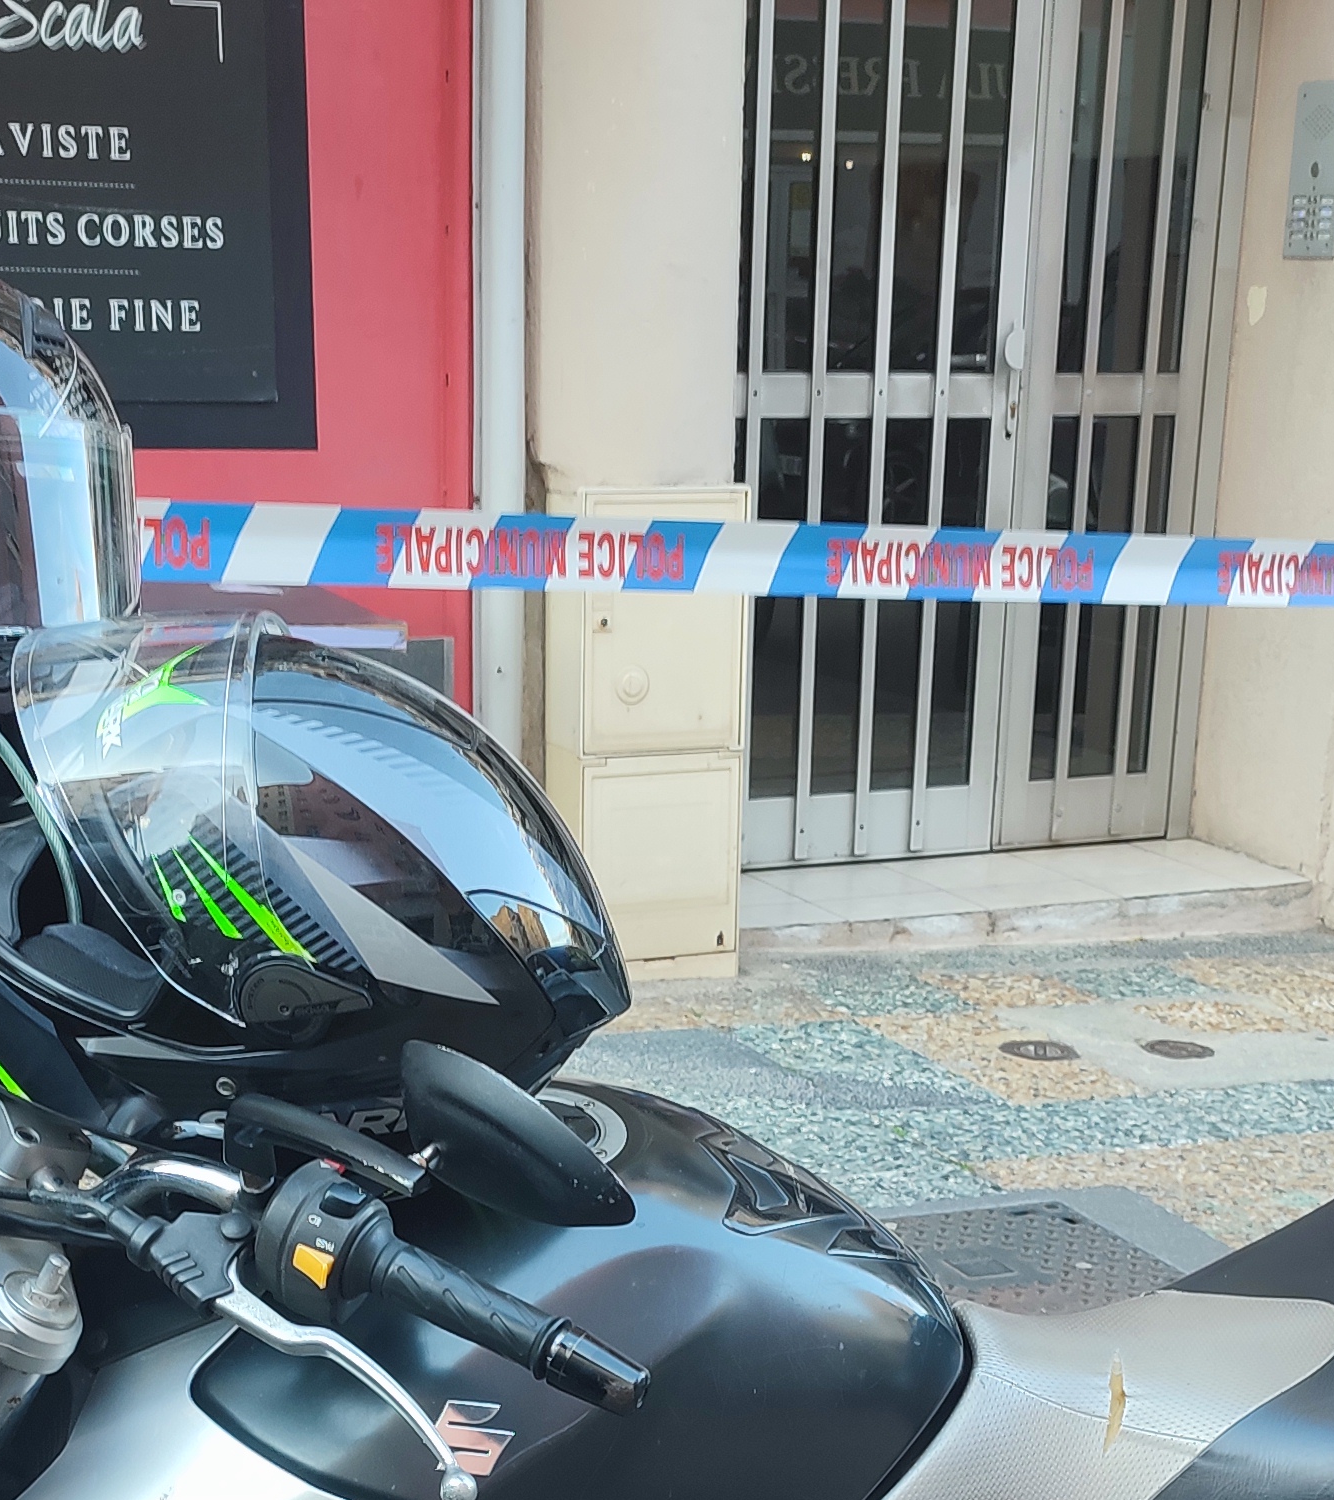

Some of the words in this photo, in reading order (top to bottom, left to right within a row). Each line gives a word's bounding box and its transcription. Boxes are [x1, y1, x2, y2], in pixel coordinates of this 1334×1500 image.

[77, 213, 225, 250] CORSES
[109, 298, 202, 333] FINE
[375, 522, 567, 580] MUNICIPALE
[578, 530, 685, 582] POLICE
[1000, 544, 1094, 592] POLICE
